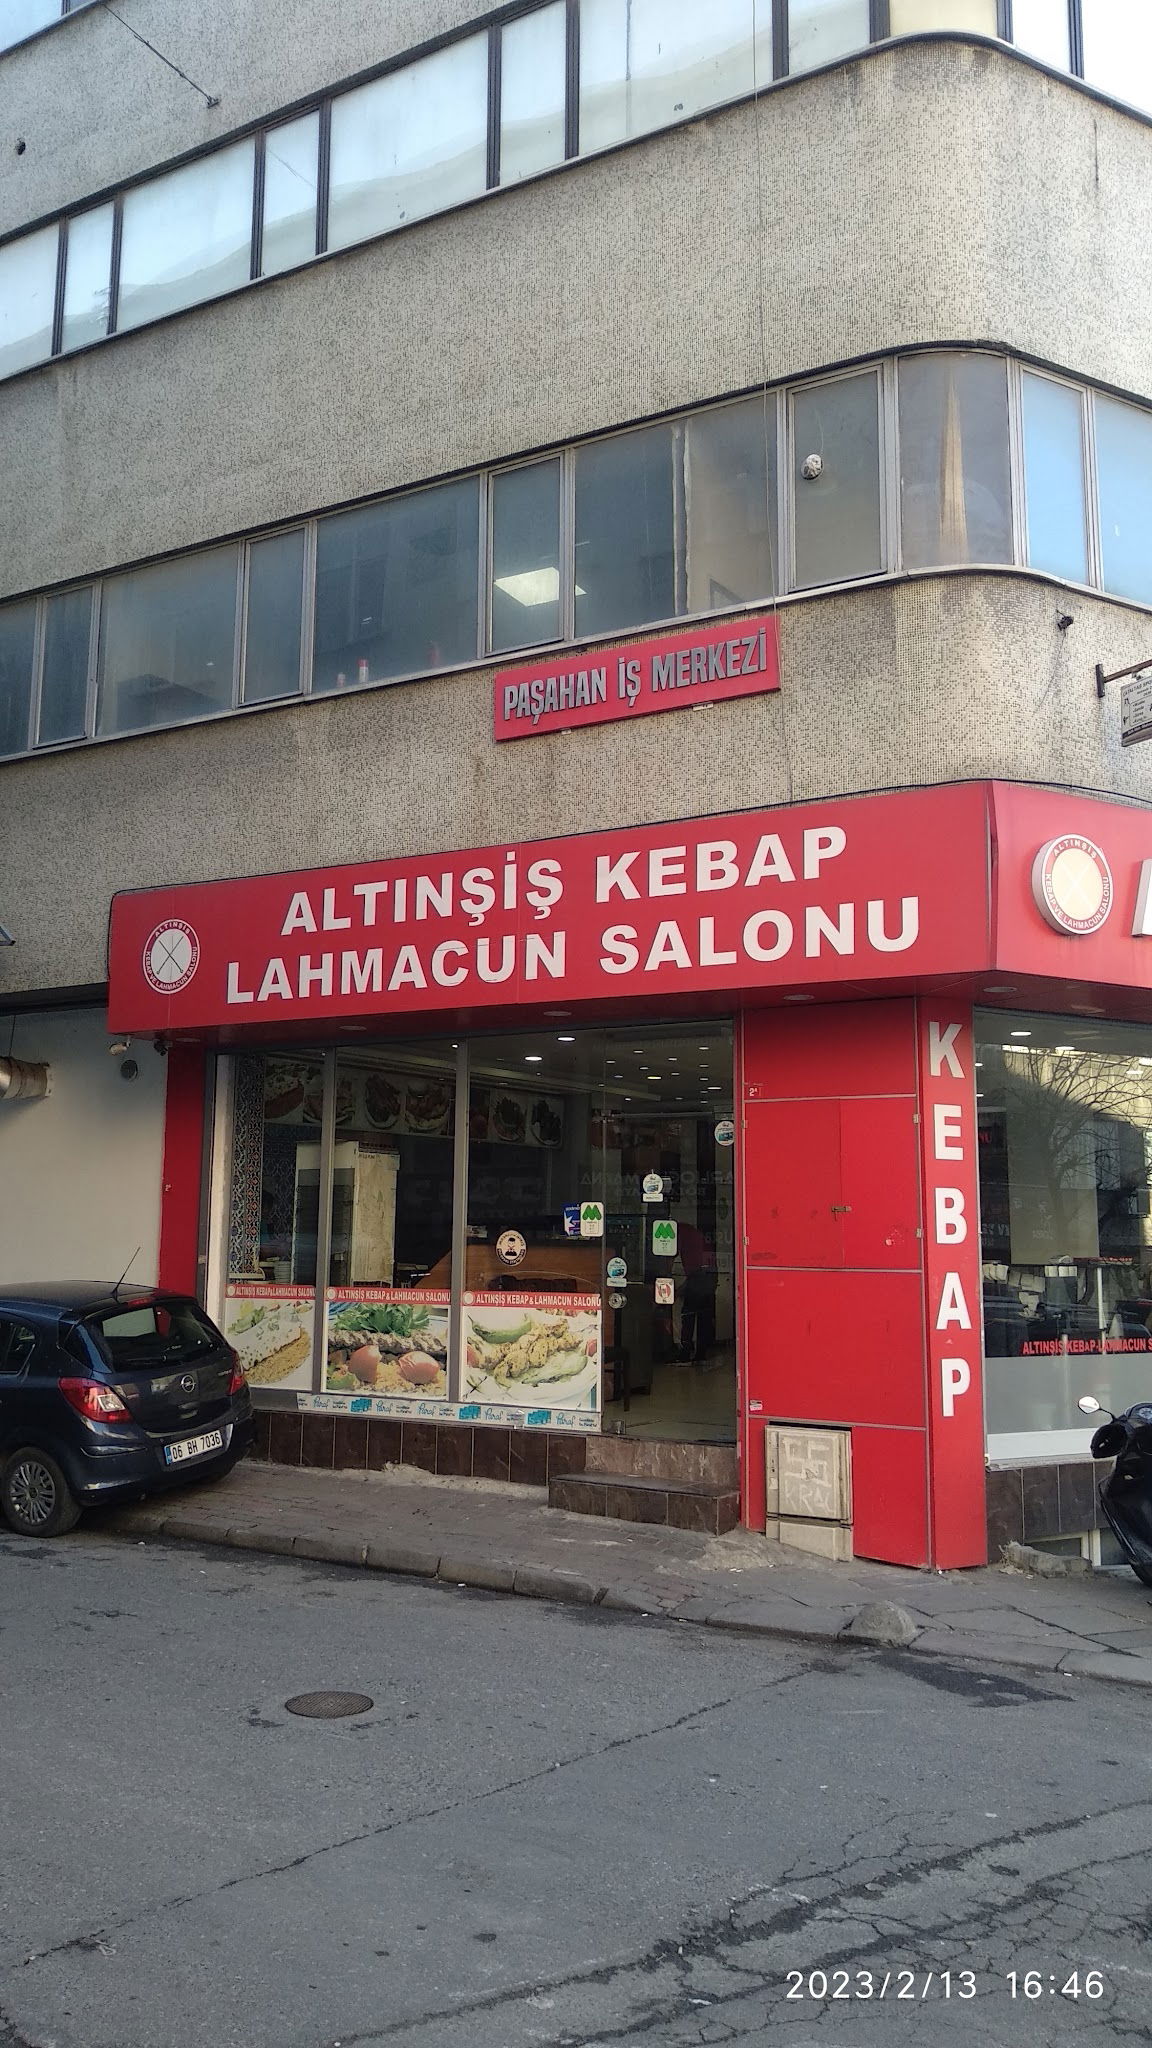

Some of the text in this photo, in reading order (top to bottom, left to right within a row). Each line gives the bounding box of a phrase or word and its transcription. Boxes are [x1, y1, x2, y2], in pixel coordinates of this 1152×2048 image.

[504, 628, 767, 725] PAŞAHAN İŞ MERKEZİ
[280, 826, 848, 936] ALTINŞİŞ KEBAP
[227, 896, 920, 1004] LAHMACUN SALONU
[929, 1021, 972, 1418] KEBAP
[172, 1445, 183, 1460] 06
[188, 1440, 198, 1455] BH
[201, 1432, 220, 1452] 7036
